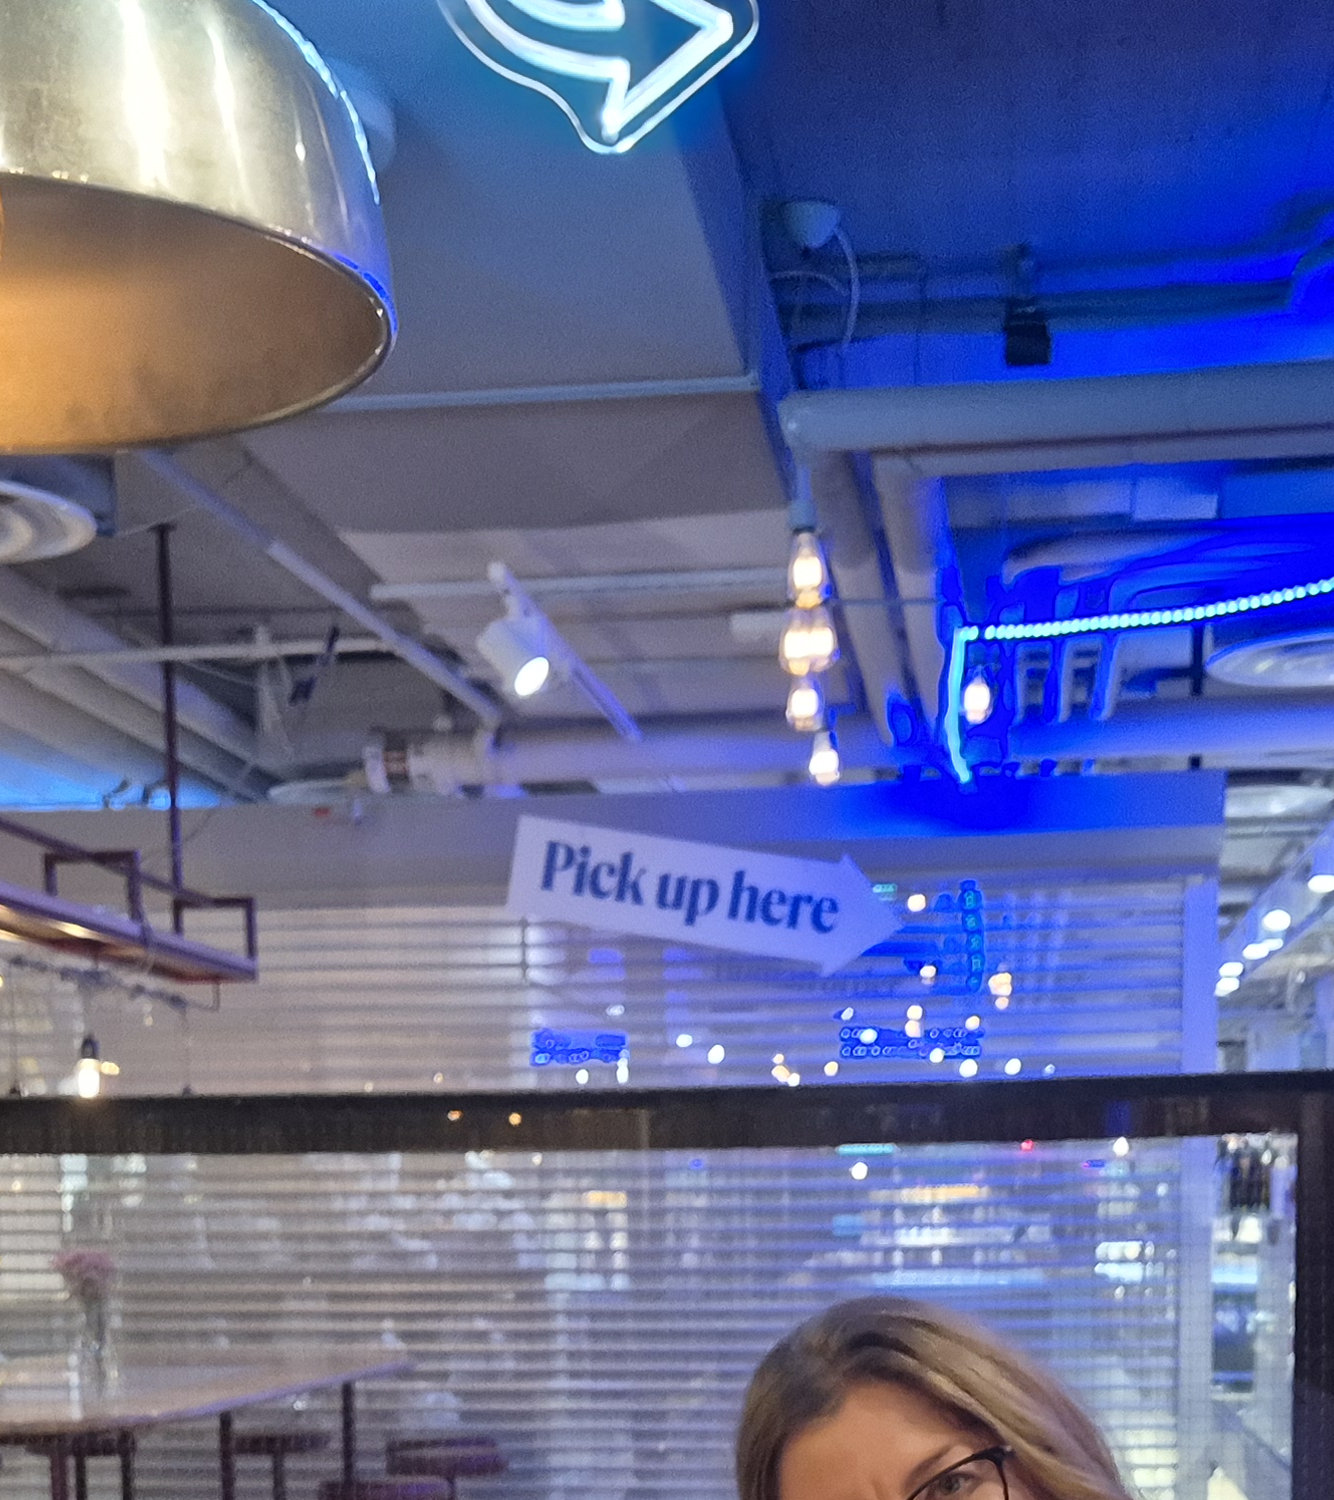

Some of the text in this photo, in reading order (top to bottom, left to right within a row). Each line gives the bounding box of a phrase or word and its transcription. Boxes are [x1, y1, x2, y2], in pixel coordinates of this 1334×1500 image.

[540, 839, 841, 935] Pick up here
